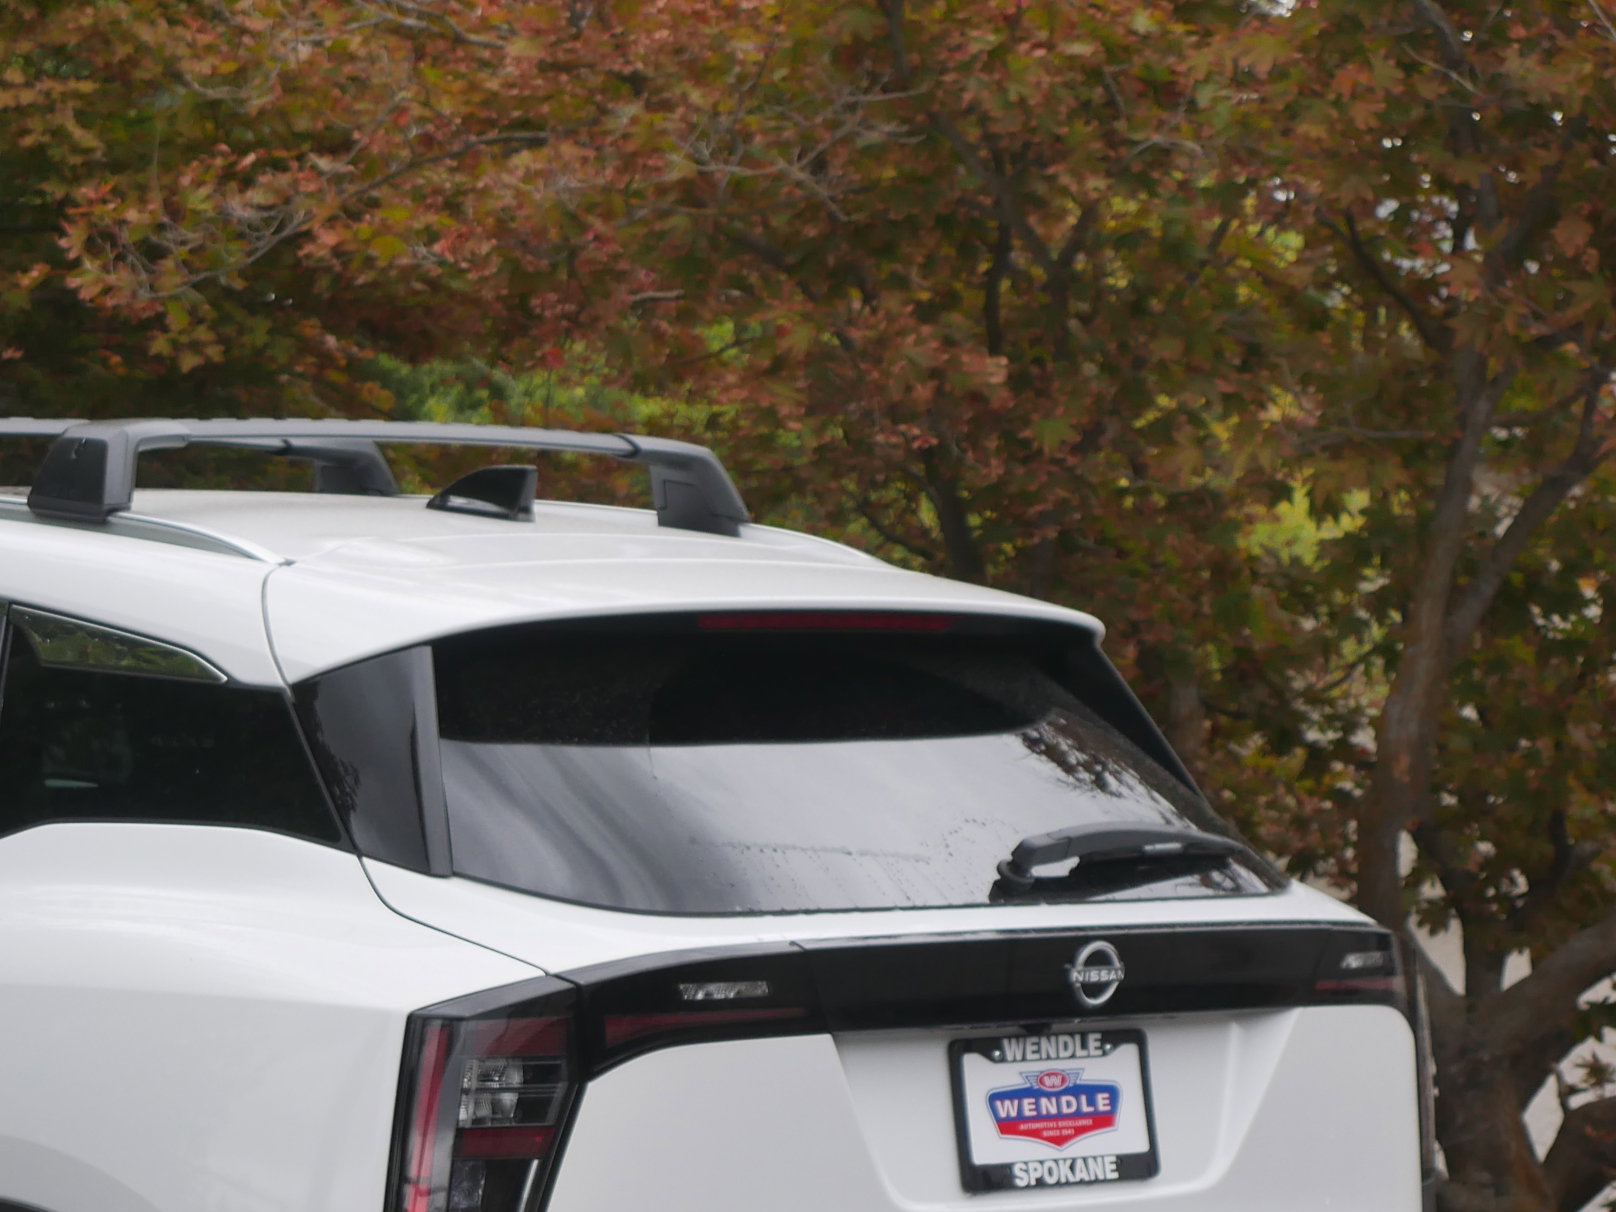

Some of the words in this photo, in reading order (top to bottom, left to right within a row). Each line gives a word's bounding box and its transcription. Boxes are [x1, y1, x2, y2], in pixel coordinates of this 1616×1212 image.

[1072, 968, 1126, 983] NISSAN
[1003, 1032, 1104, 1062] WENDLE
[995, 1092, 1112, 1119] WENDLE
[1012, 1155, 1120, 1188] SPOKANE
